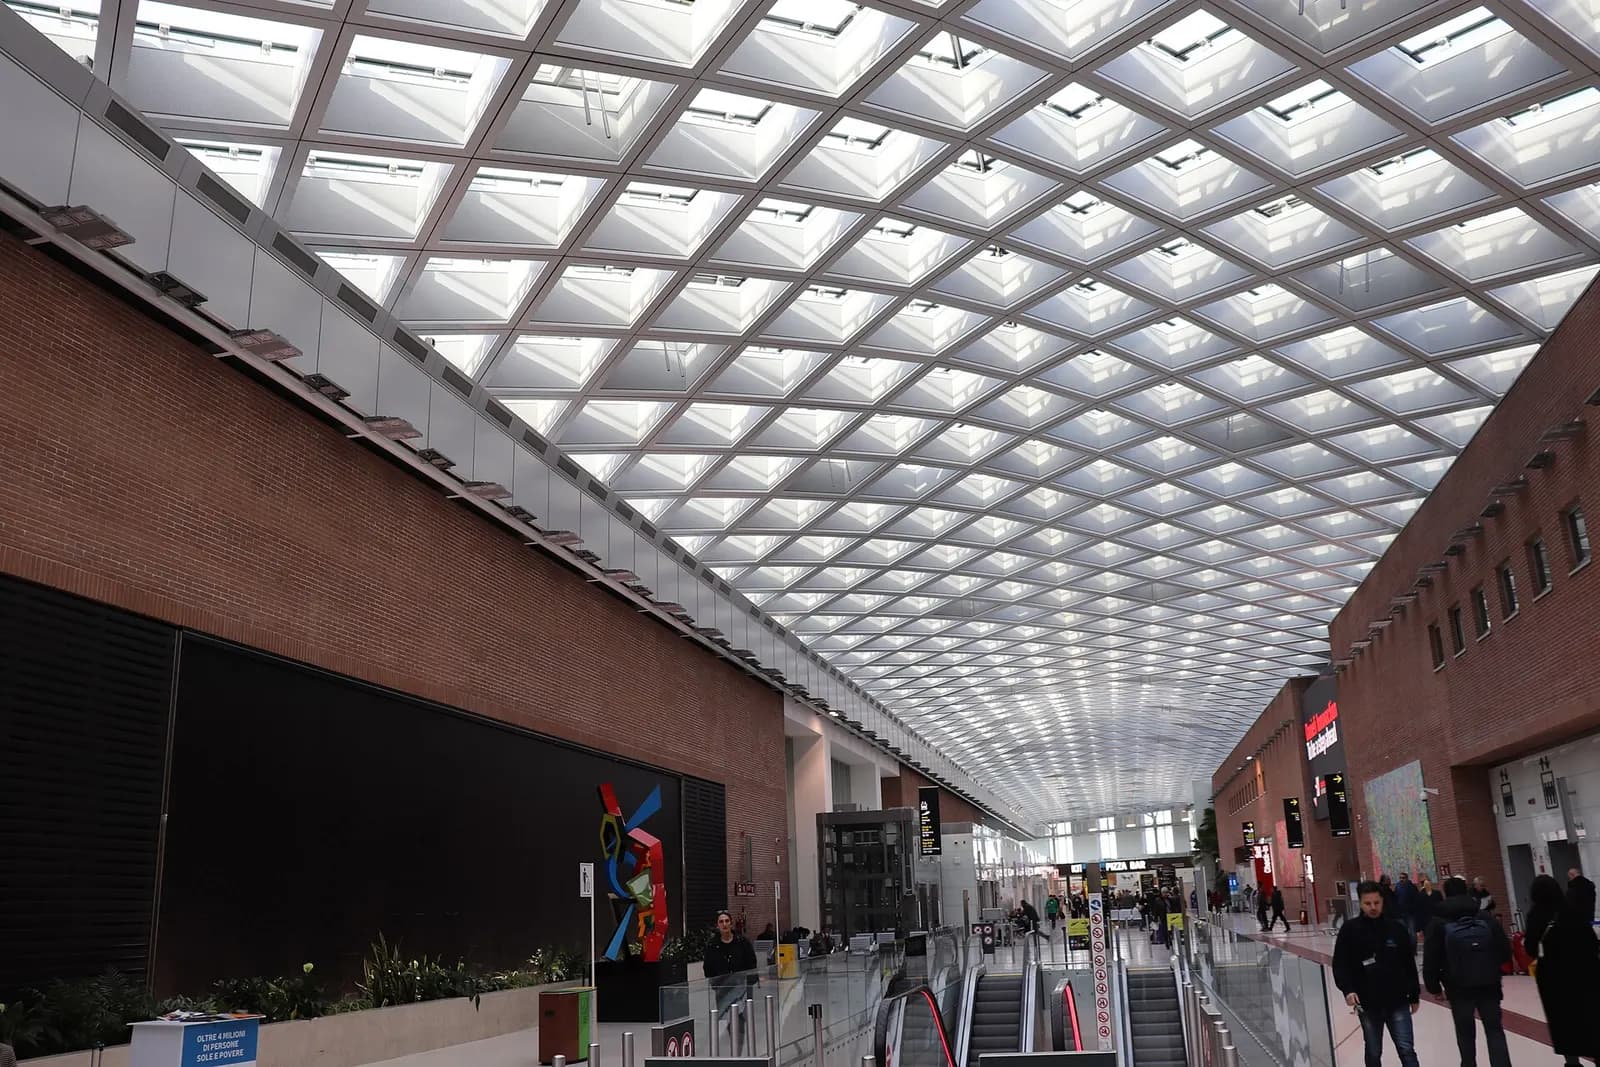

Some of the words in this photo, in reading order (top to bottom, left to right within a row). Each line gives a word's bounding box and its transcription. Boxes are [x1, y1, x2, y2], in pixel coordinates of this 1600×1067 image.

[1106, 861, 1127, 871] PIZZA
[1130, 861, 1146, 869] BAR
[196, 1034, 217, 1043] OLTRE
[217, 1032, 222, 1040] 4
[222, 1030, 246, 1039] MILIONI
[203, 1044, 210, 1052] DI
[210, 1040, 239, 1051] PERSONE
[196, 1054, 213, 1062] SOLE
[213, 1052, 218, 1060] E
[219, 1049, 244, 1058] POVERE
